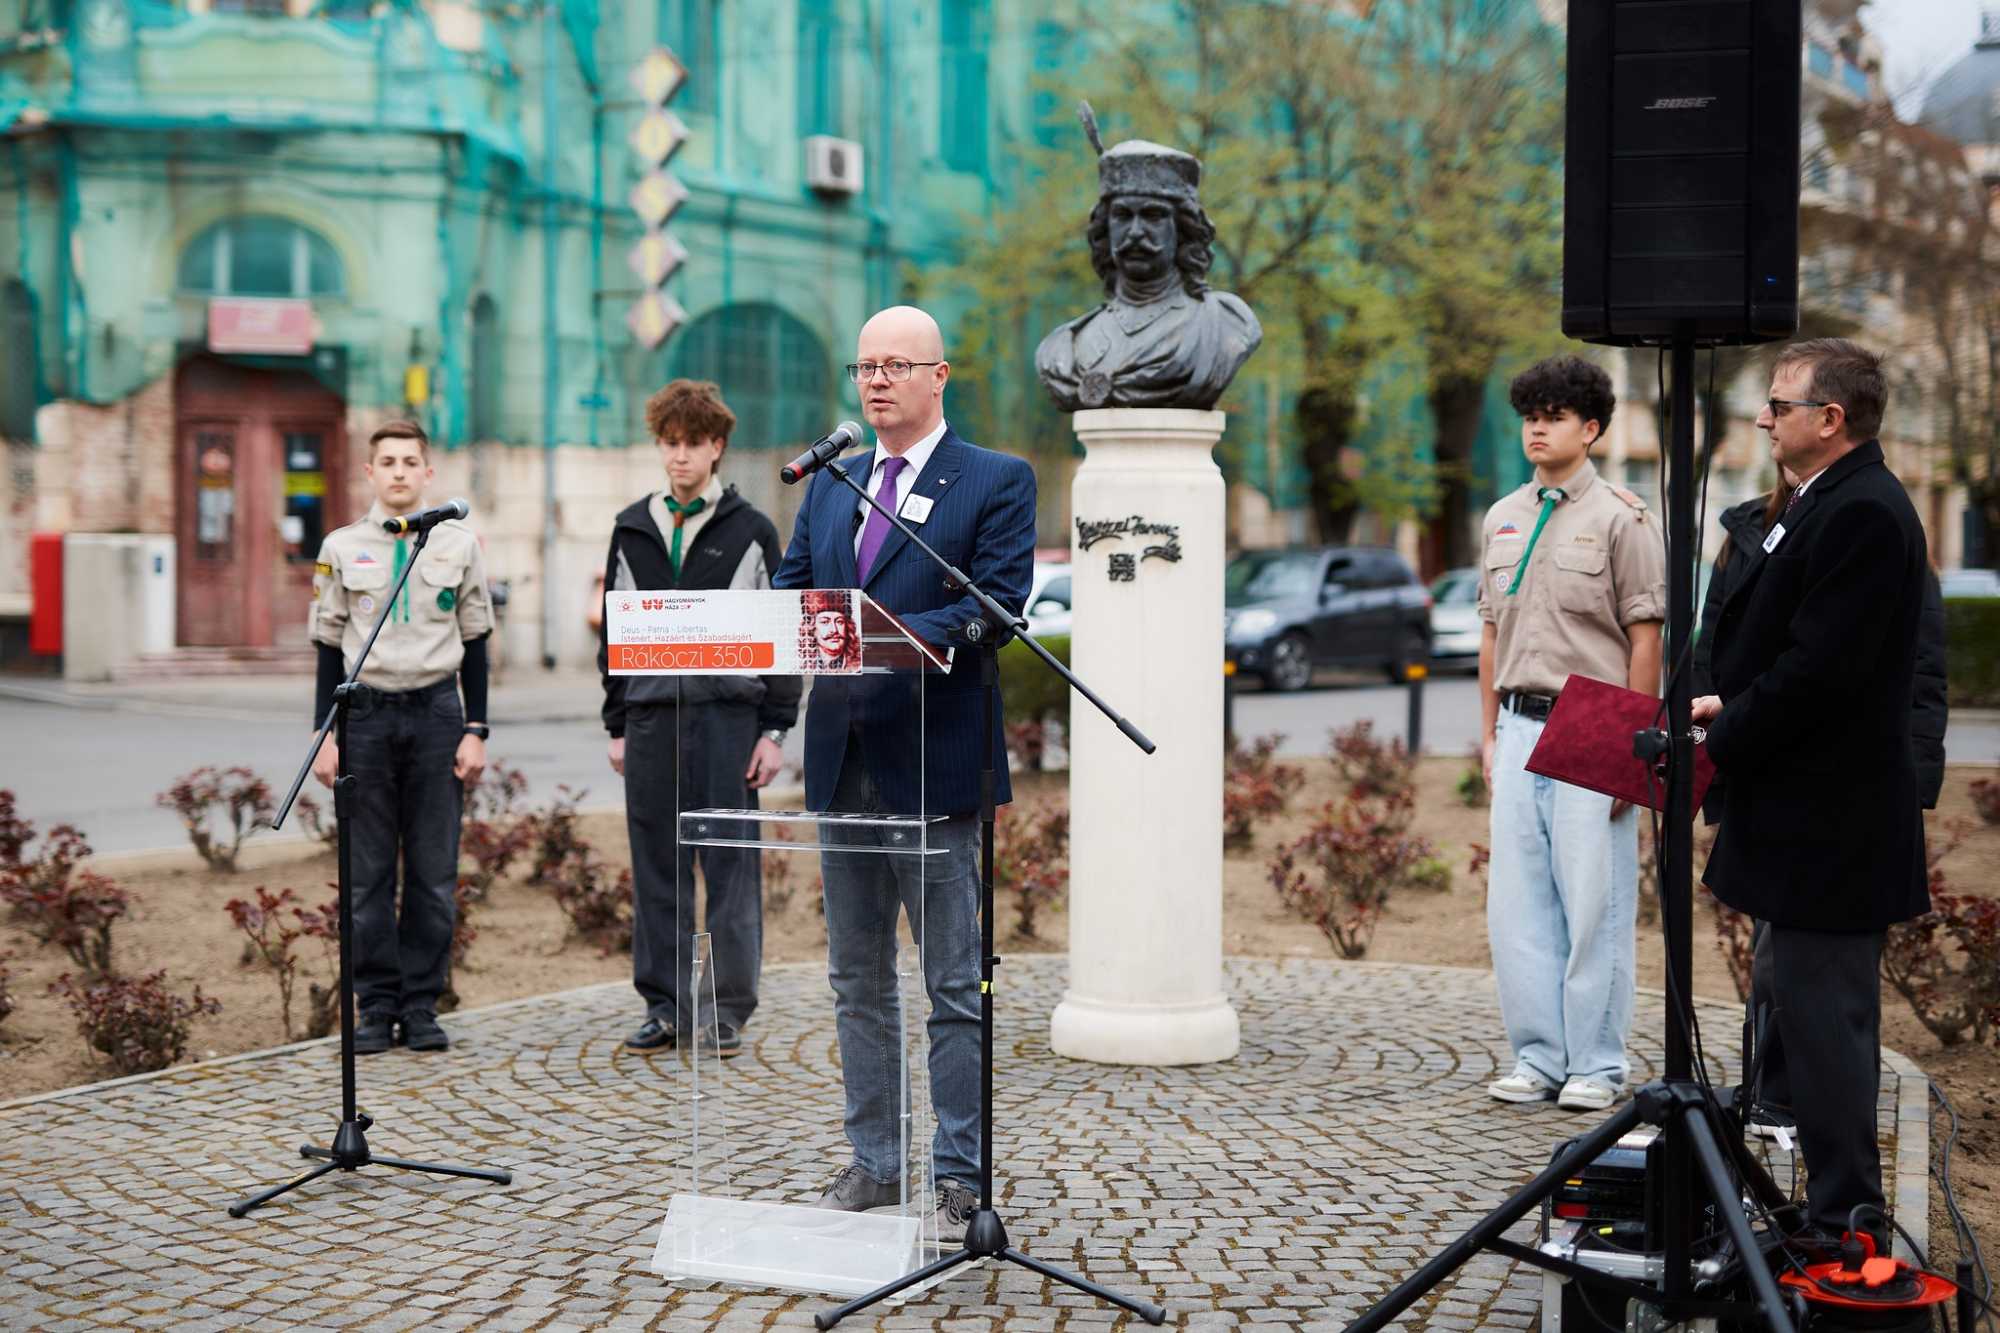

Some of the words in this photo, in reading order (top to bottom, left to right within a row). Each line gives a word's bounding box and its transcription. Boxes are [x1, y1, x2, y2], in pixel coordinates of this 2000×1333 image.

[1643, 96, 1717, 110] BOSE
[621, 625, 640, 634] Deus
[677, 625, 708, 633] Libertas
[621, 645, 704, 668] Rákóczi
[711, 645, 754, 668] 350
